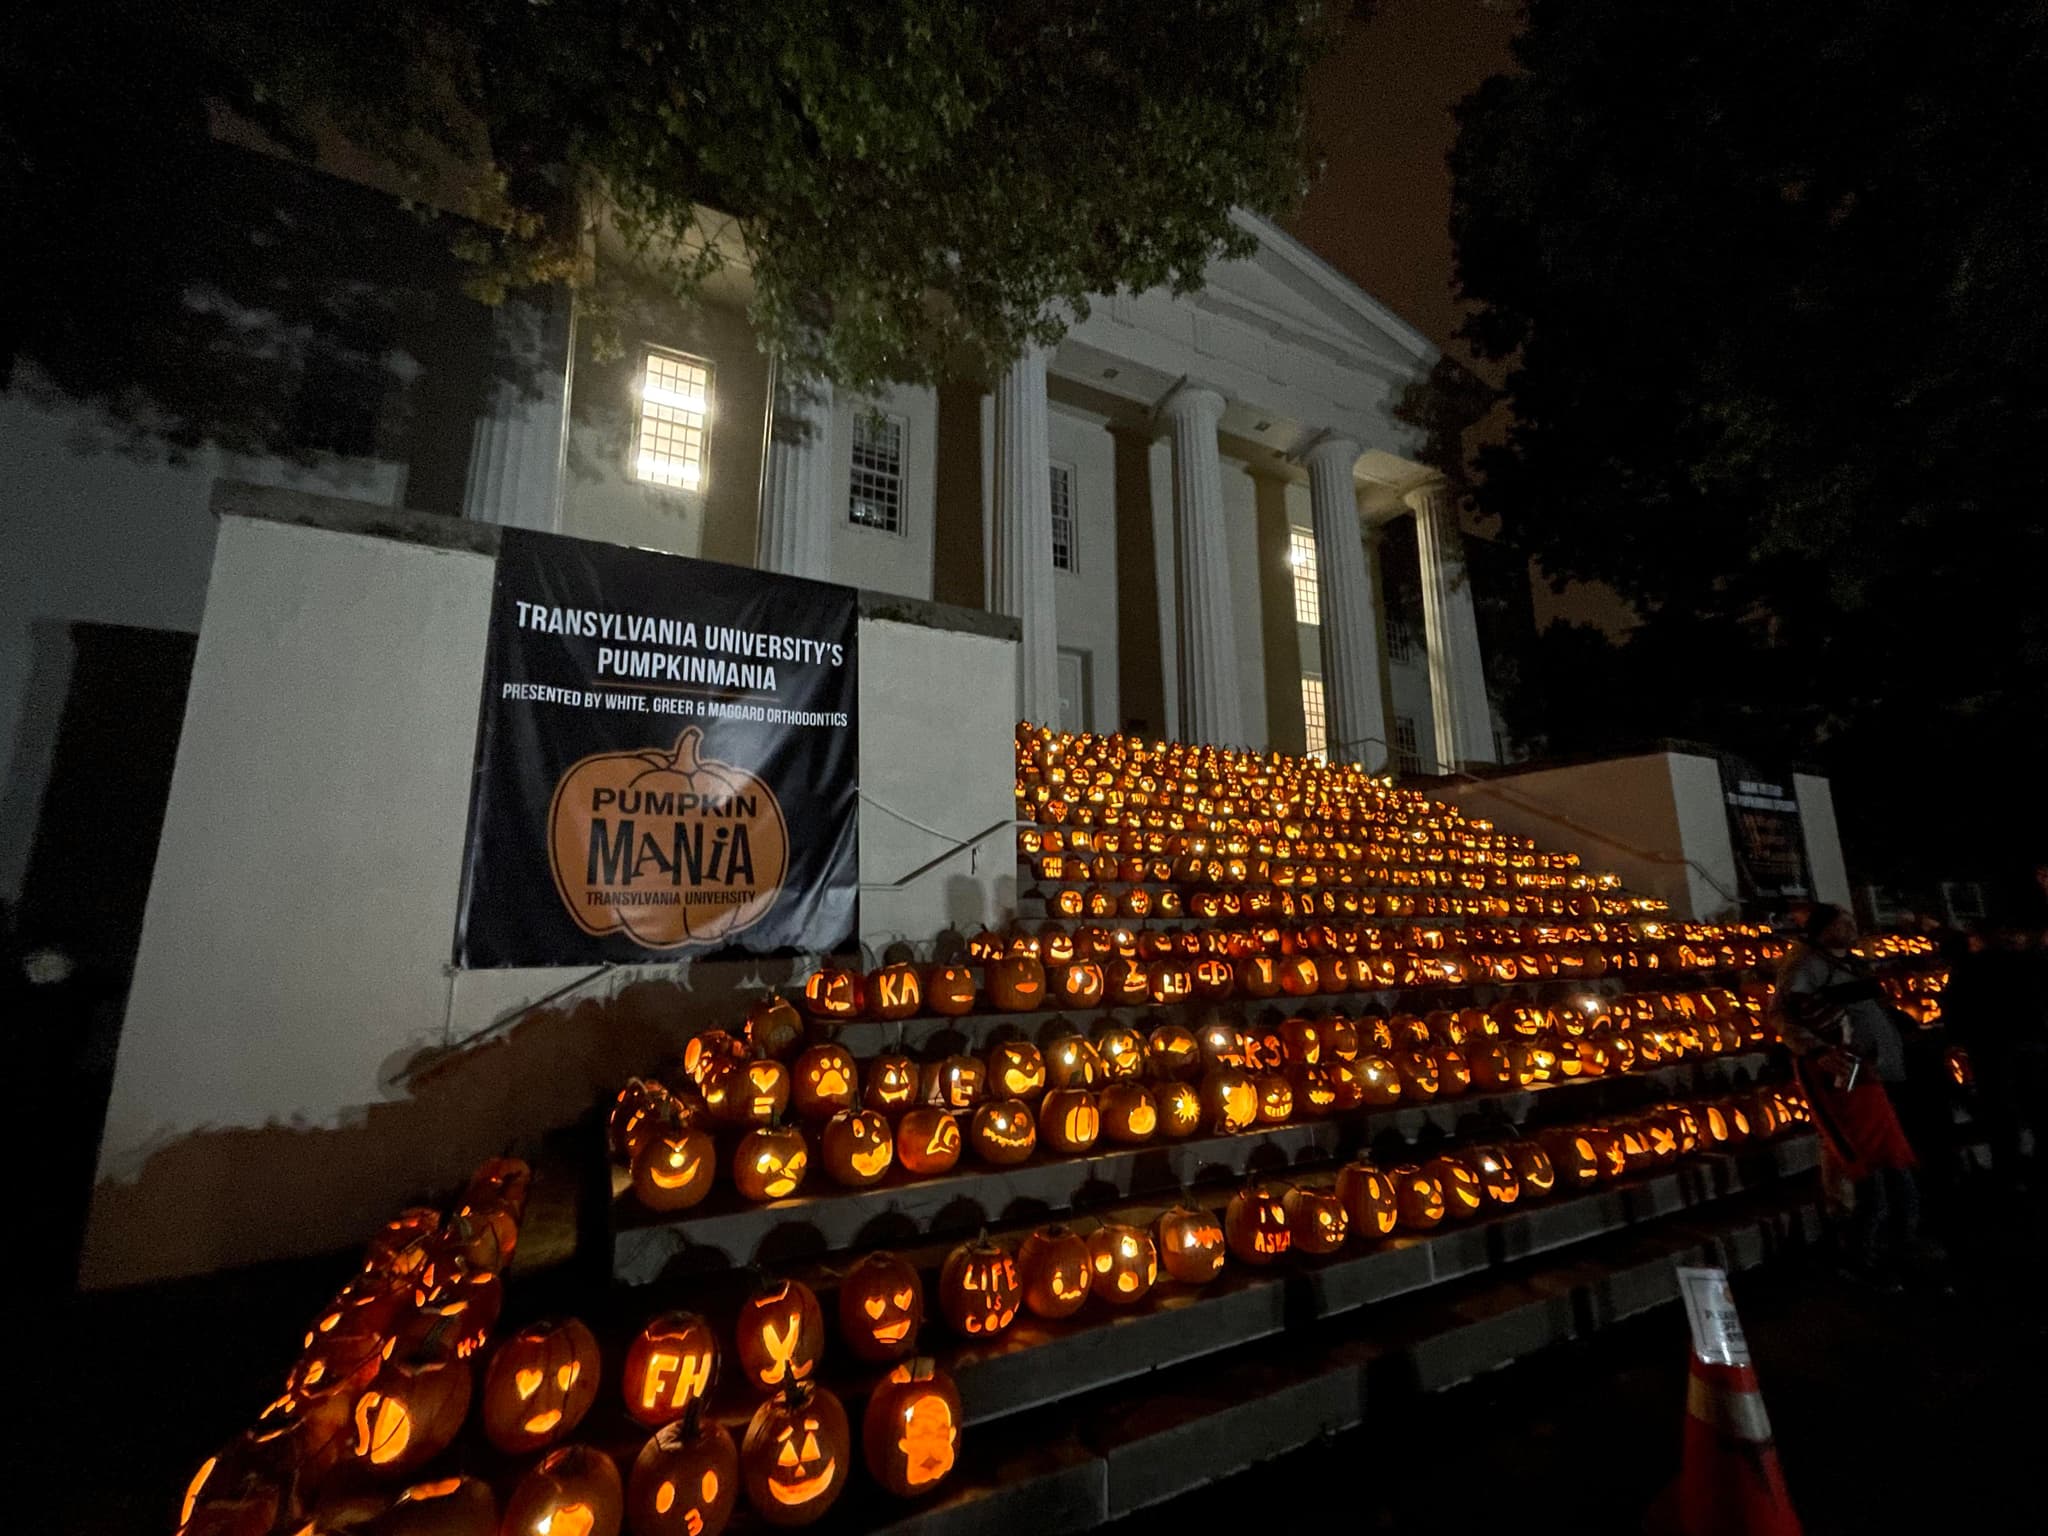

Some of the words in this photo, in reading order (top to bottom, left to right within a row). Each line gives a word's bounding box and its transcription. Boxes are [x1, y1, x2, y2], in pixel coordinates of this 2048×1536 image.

[516, 601, 697, 648] TRANSYLVANIA
[705, 625, 843, 666] UNIVERSITY'S
[598, 647, 777, 691] PUMPKINMANIA
[502, 683, 581, 706] PRESENTED
[584, 692, 602, 708] BY
[605, 694, 650, 713] WHITE,
[653, 697, 694, 715] GREER
[697, 701, 705, 716] &
[708, 702, 765, 722] MAGGARD
[766, 708, 848, 727] ORTHODONTICS
[592, 788, 757, 817] PUMPKIN
[586, 891, 681, 906] TRANSYLVANIA
[685, 891, 756, 905] UNIVERSITY
[963, 1259, 1019, 1292] LIFE
[965, 1301, 1019, 1333] GOO
[986, 1295, 1002, 1311] IS
[643, 1352, 712, 1408] FH
